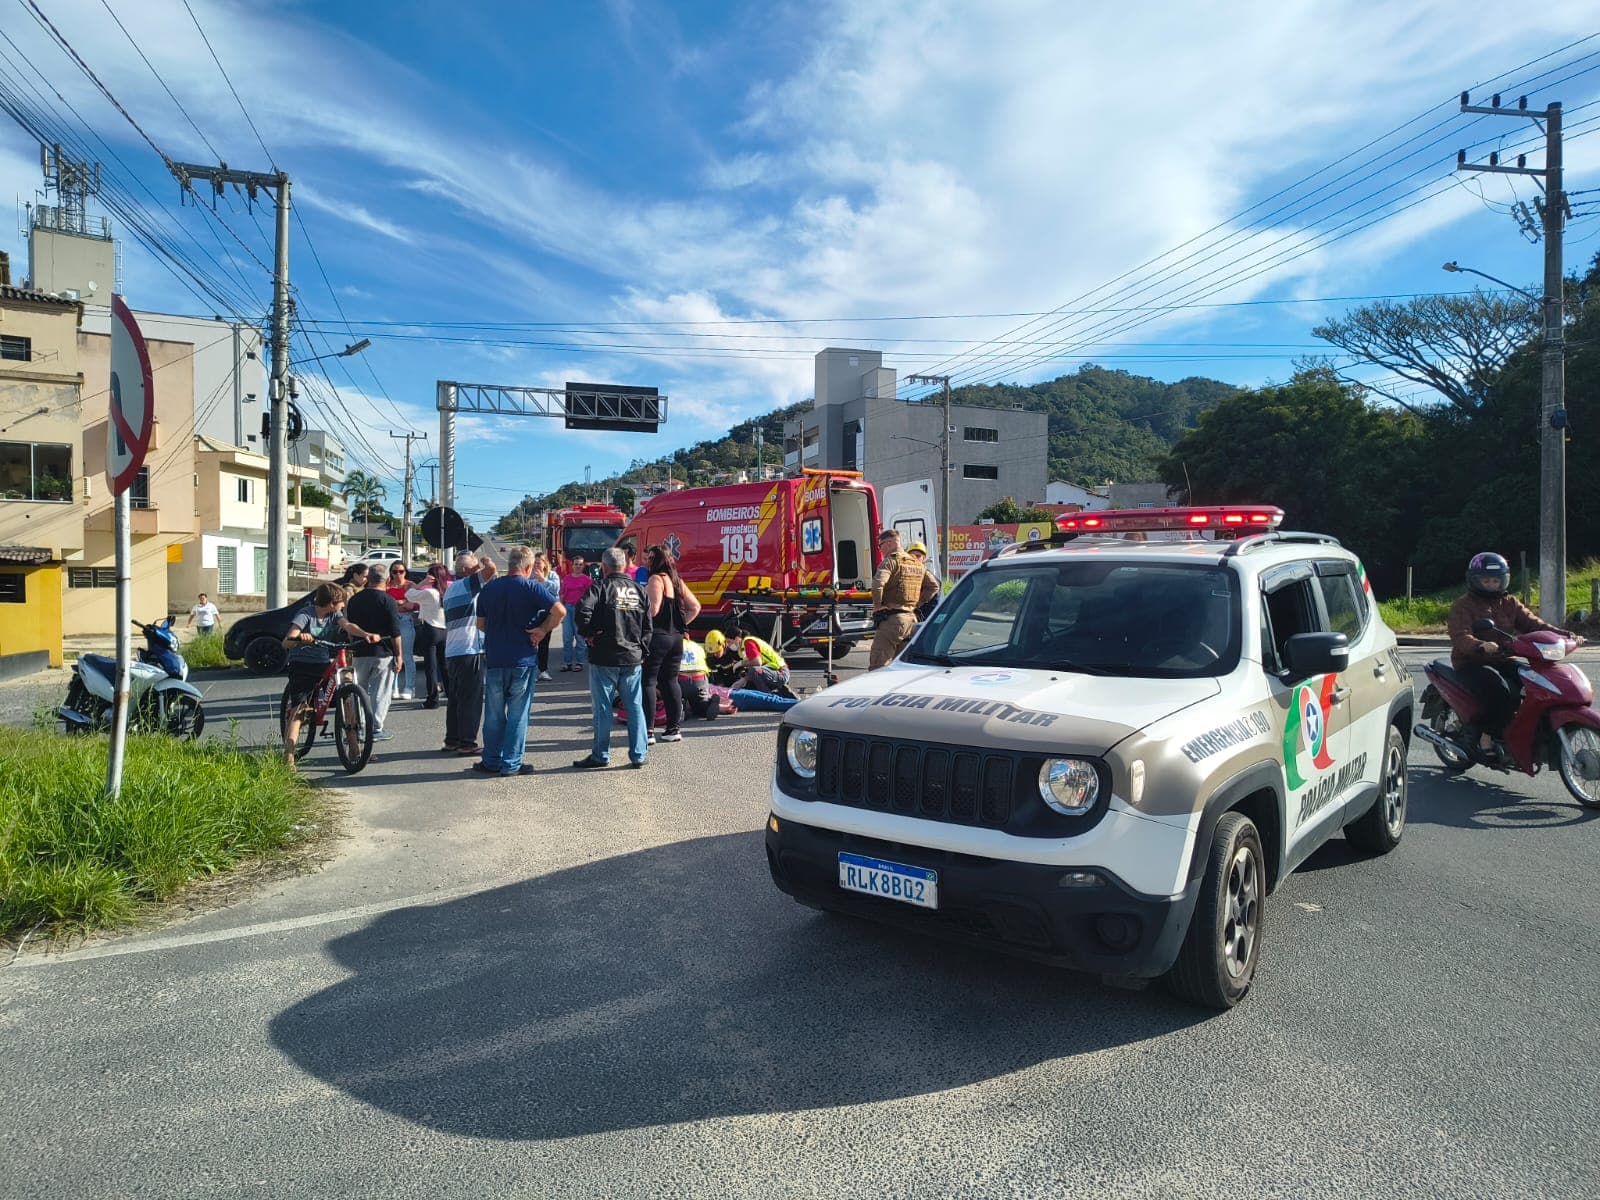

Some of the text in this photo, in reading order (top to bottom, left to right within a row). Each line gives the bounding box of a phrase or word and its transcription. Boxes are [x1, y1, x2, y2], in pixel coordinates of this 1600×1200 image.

[804, 487, 826, 503] BOMB
[706, 505, 761, 522] BOMBEIROS
[719, 534, 760, 564] 193
[973, 541, 986, 550] no
[932, 695, 1059, 727] MILITAR
[1248, 710, 1271, 734] 190
[1295, 752, 1367, 828] POLÍCIA MILITAR
